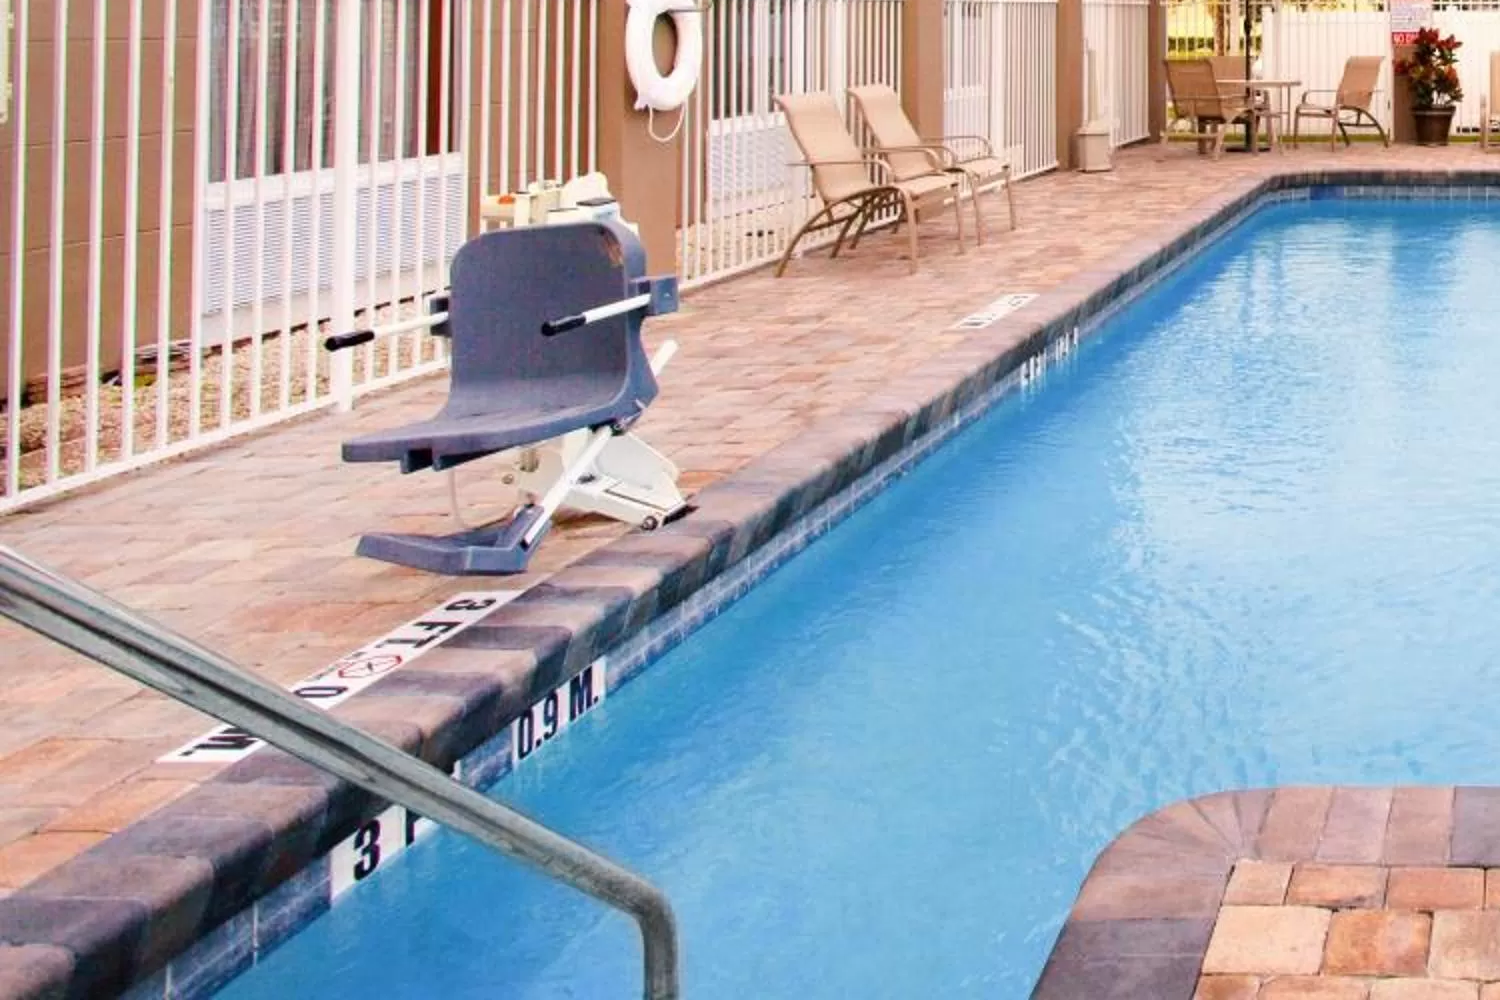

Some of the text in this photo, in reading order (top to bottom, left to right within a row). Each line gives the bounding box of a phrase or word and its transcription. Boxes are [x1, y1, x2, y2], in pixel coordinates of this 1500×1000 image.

[445, 598, 496, 611] 3
[353, 818, 381, 880] 3
[516, 692, 559, 760] 0.9
[568, 667, 600, 723] M.
